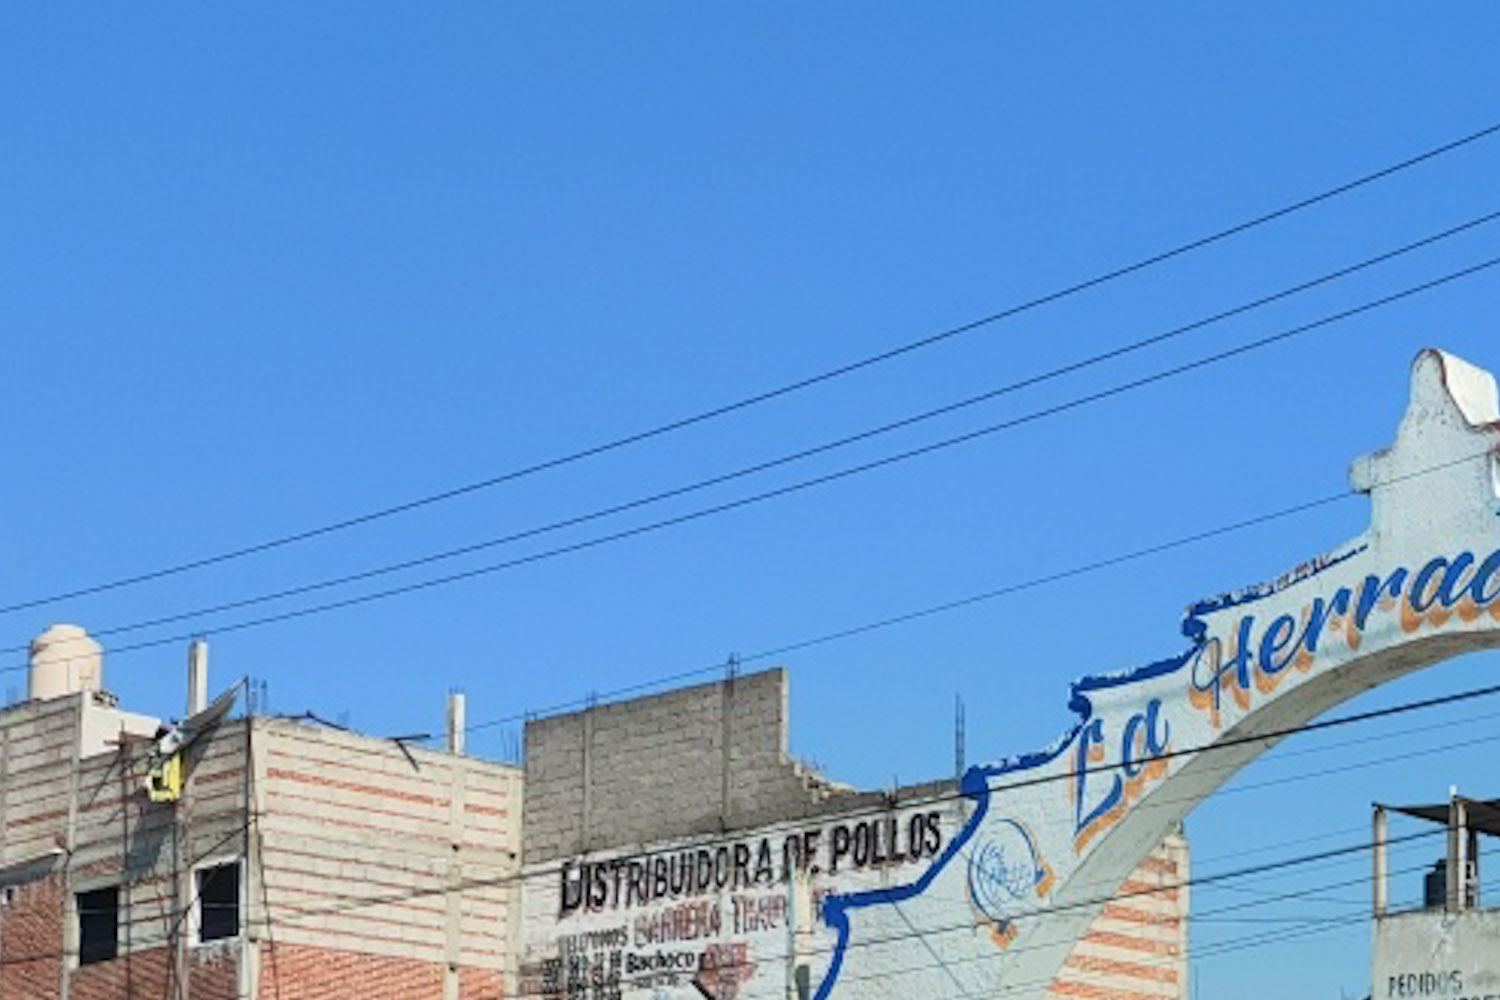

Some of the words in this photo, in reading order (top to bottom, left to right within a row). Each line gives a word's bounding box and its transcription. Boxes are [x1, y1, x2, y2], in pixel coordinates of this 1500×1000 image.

[1073, 698, 1171, 845] La
[560, 836, 771, 913] DISTRIBUIDORA
[831, 811, 941, 871] POLLOS
[627, 950, 695, 973] Bachoco
[1389, 970, 1463, 997] PEDIDOS
